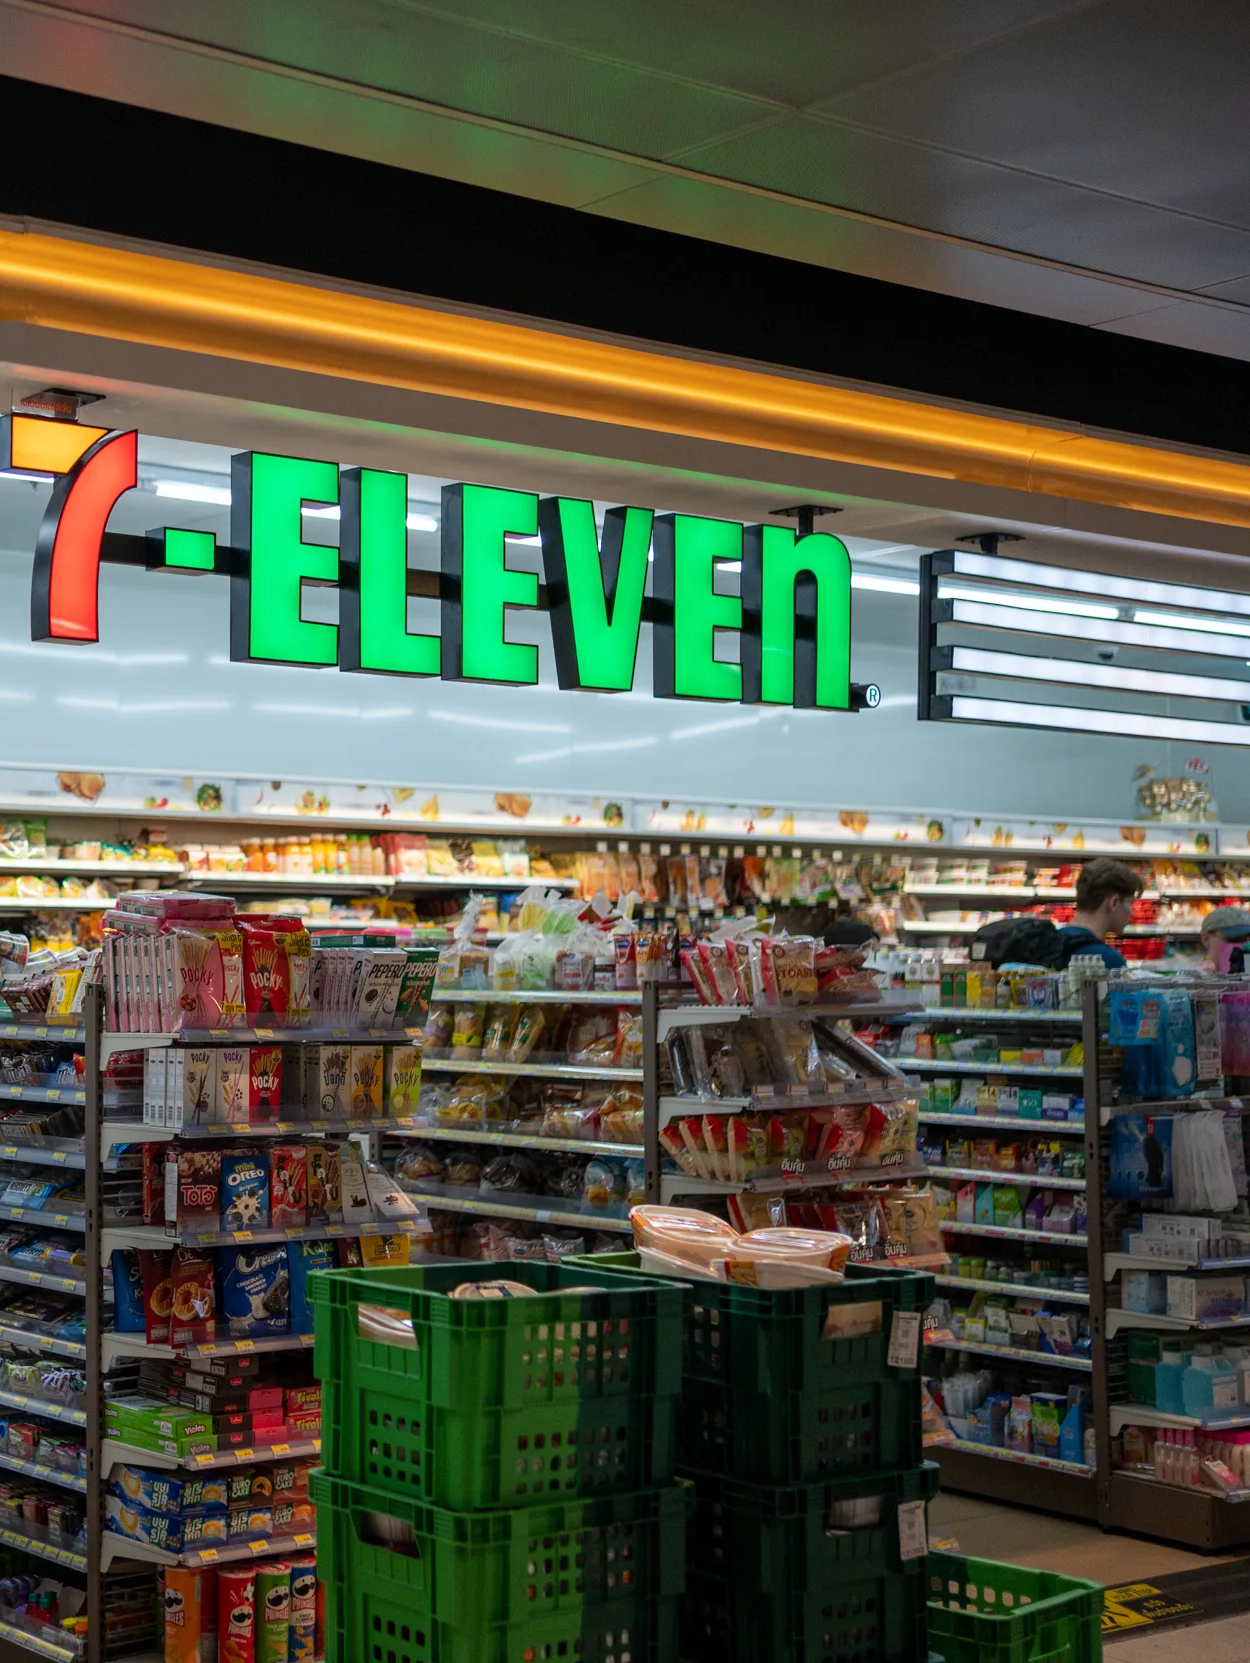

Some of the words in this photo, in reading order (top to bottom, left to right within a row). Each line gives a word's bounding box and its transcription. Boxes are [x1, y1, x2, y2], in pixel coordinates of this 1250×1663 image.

[368, 964, 406, 979] PEPERO
[403, 962, 437, 977] PEPERO
[234, 1161, 255, 1173] mini
[226, 1168, 265, 1187] OREO
[237, 1273, 265, 1288] CHOCOLATE
[232, 1479, 251, 1491] EURO
[275, 1473, 294, 1484] EURO
[232, 1487, 250, 1498] CAKE
